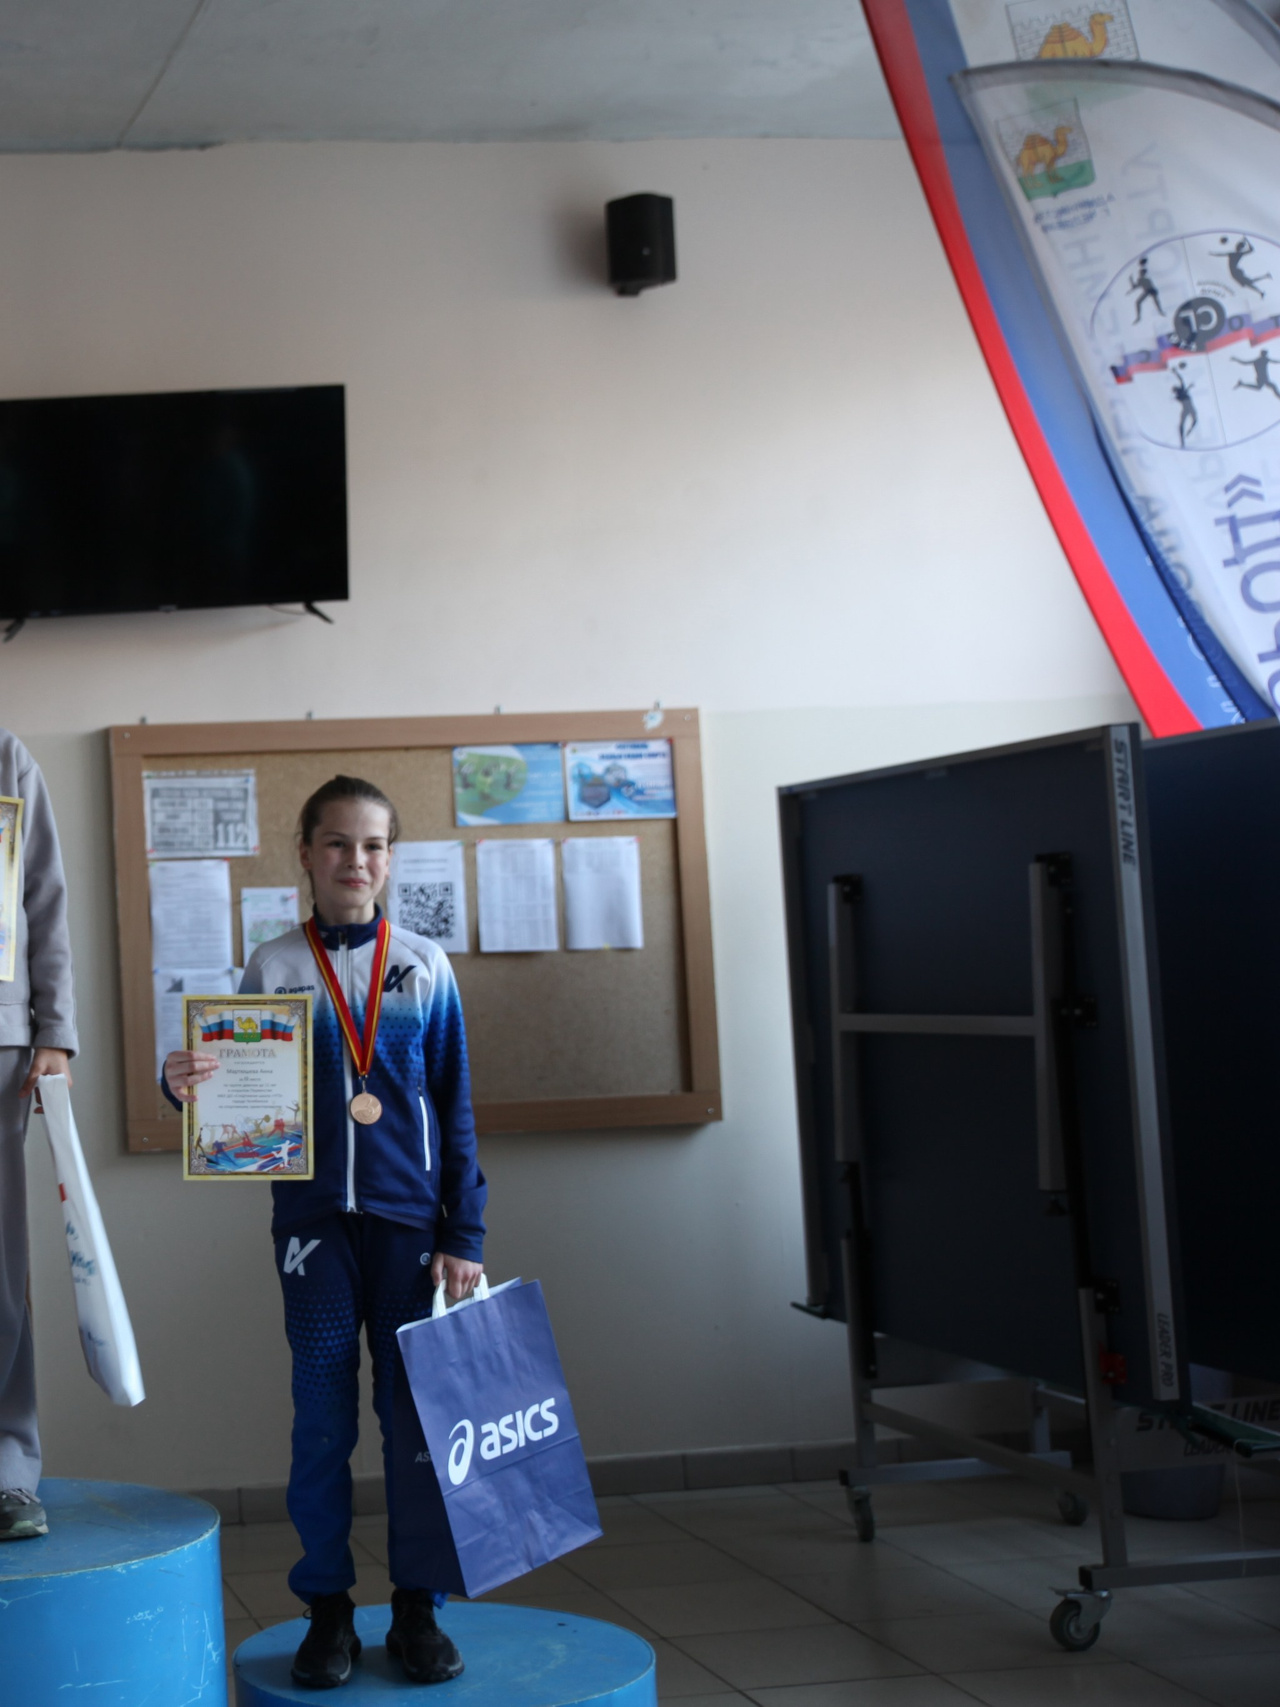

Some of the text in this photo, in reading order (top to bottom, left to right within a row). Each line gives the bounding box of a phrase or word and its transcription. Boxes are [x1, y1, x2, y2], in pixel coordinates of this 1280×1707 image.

[1119, 818, 1137, 866] LINE
[288, 984, 315, 995] agapas
[218, 1048, 277, 1059] ГРАМОТА
